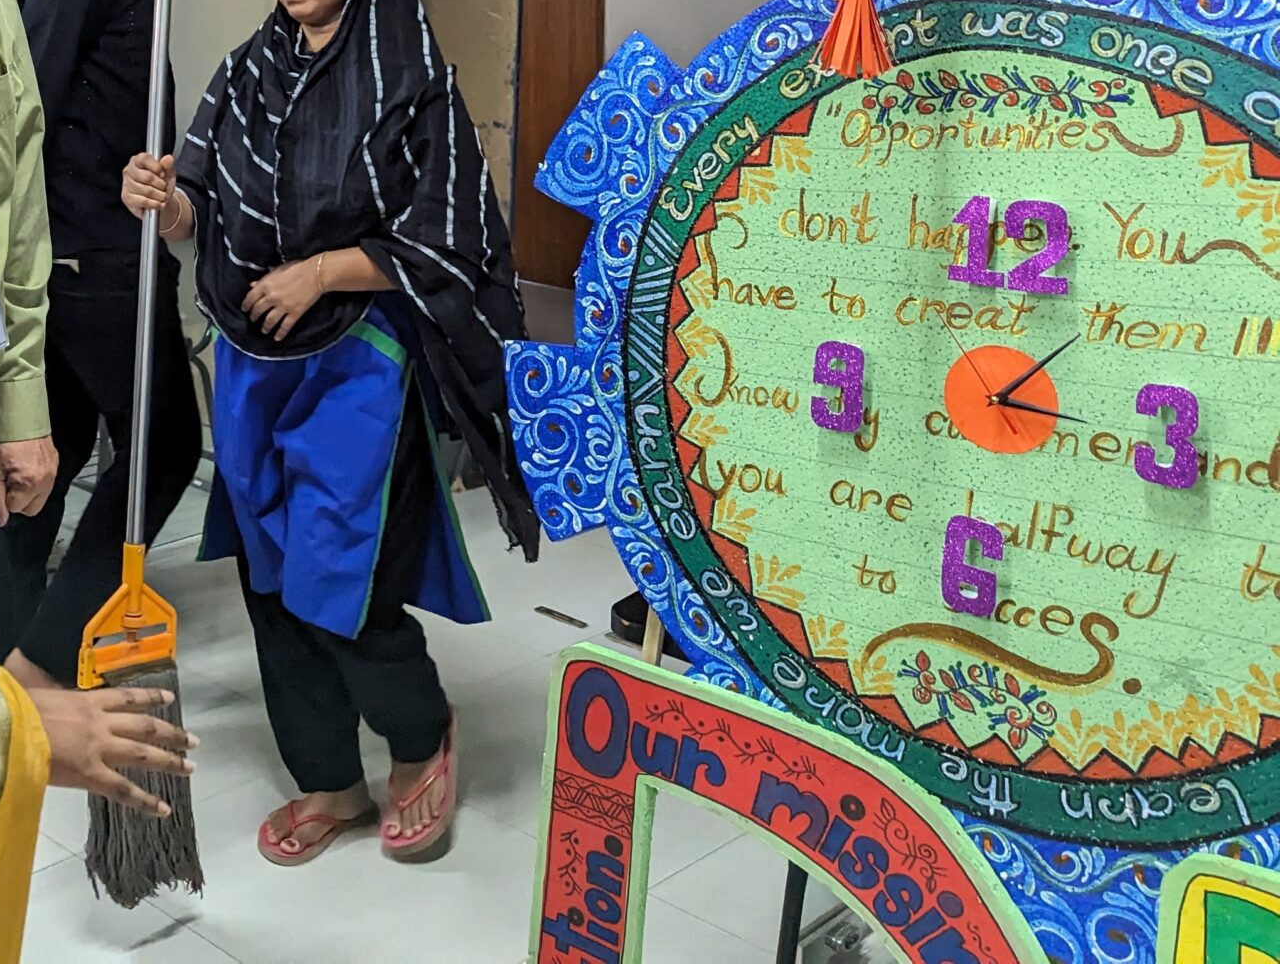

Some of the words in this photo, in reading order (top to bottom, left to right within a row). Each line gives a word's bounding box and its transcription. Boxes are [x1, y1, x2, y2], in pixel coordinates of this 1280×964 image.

[659, 114, 760, 222] Every
[961, 9, 1070, 46] was
[1088, 29, 1215, 97] once
[947, 195, 1069, 295] 12
[1103, 201, 1198, 266] You
[820, 277, 866, 320] to
[895, 294, 1036, 336] creat
[1081, 301, 1215, 352] them
[810, 340, 865, 433] 9
[633, 402, 698, 541] earn
[1134, 383, 1200, 490] 3
[700, 452, 786, 501] you
[829, 479, 913, 523] are
[701, 567, 759, 633] we
[851, 554, 897, 594] to
[941, 515, 1004, 617] 6
[566, 667, 726, 791] Our
[771, 654, 905, 762] more
[939, 752, 1019, 819] the
[1062, 777, 1252, 827] learn
[542, 834, 625, 964] tion.
